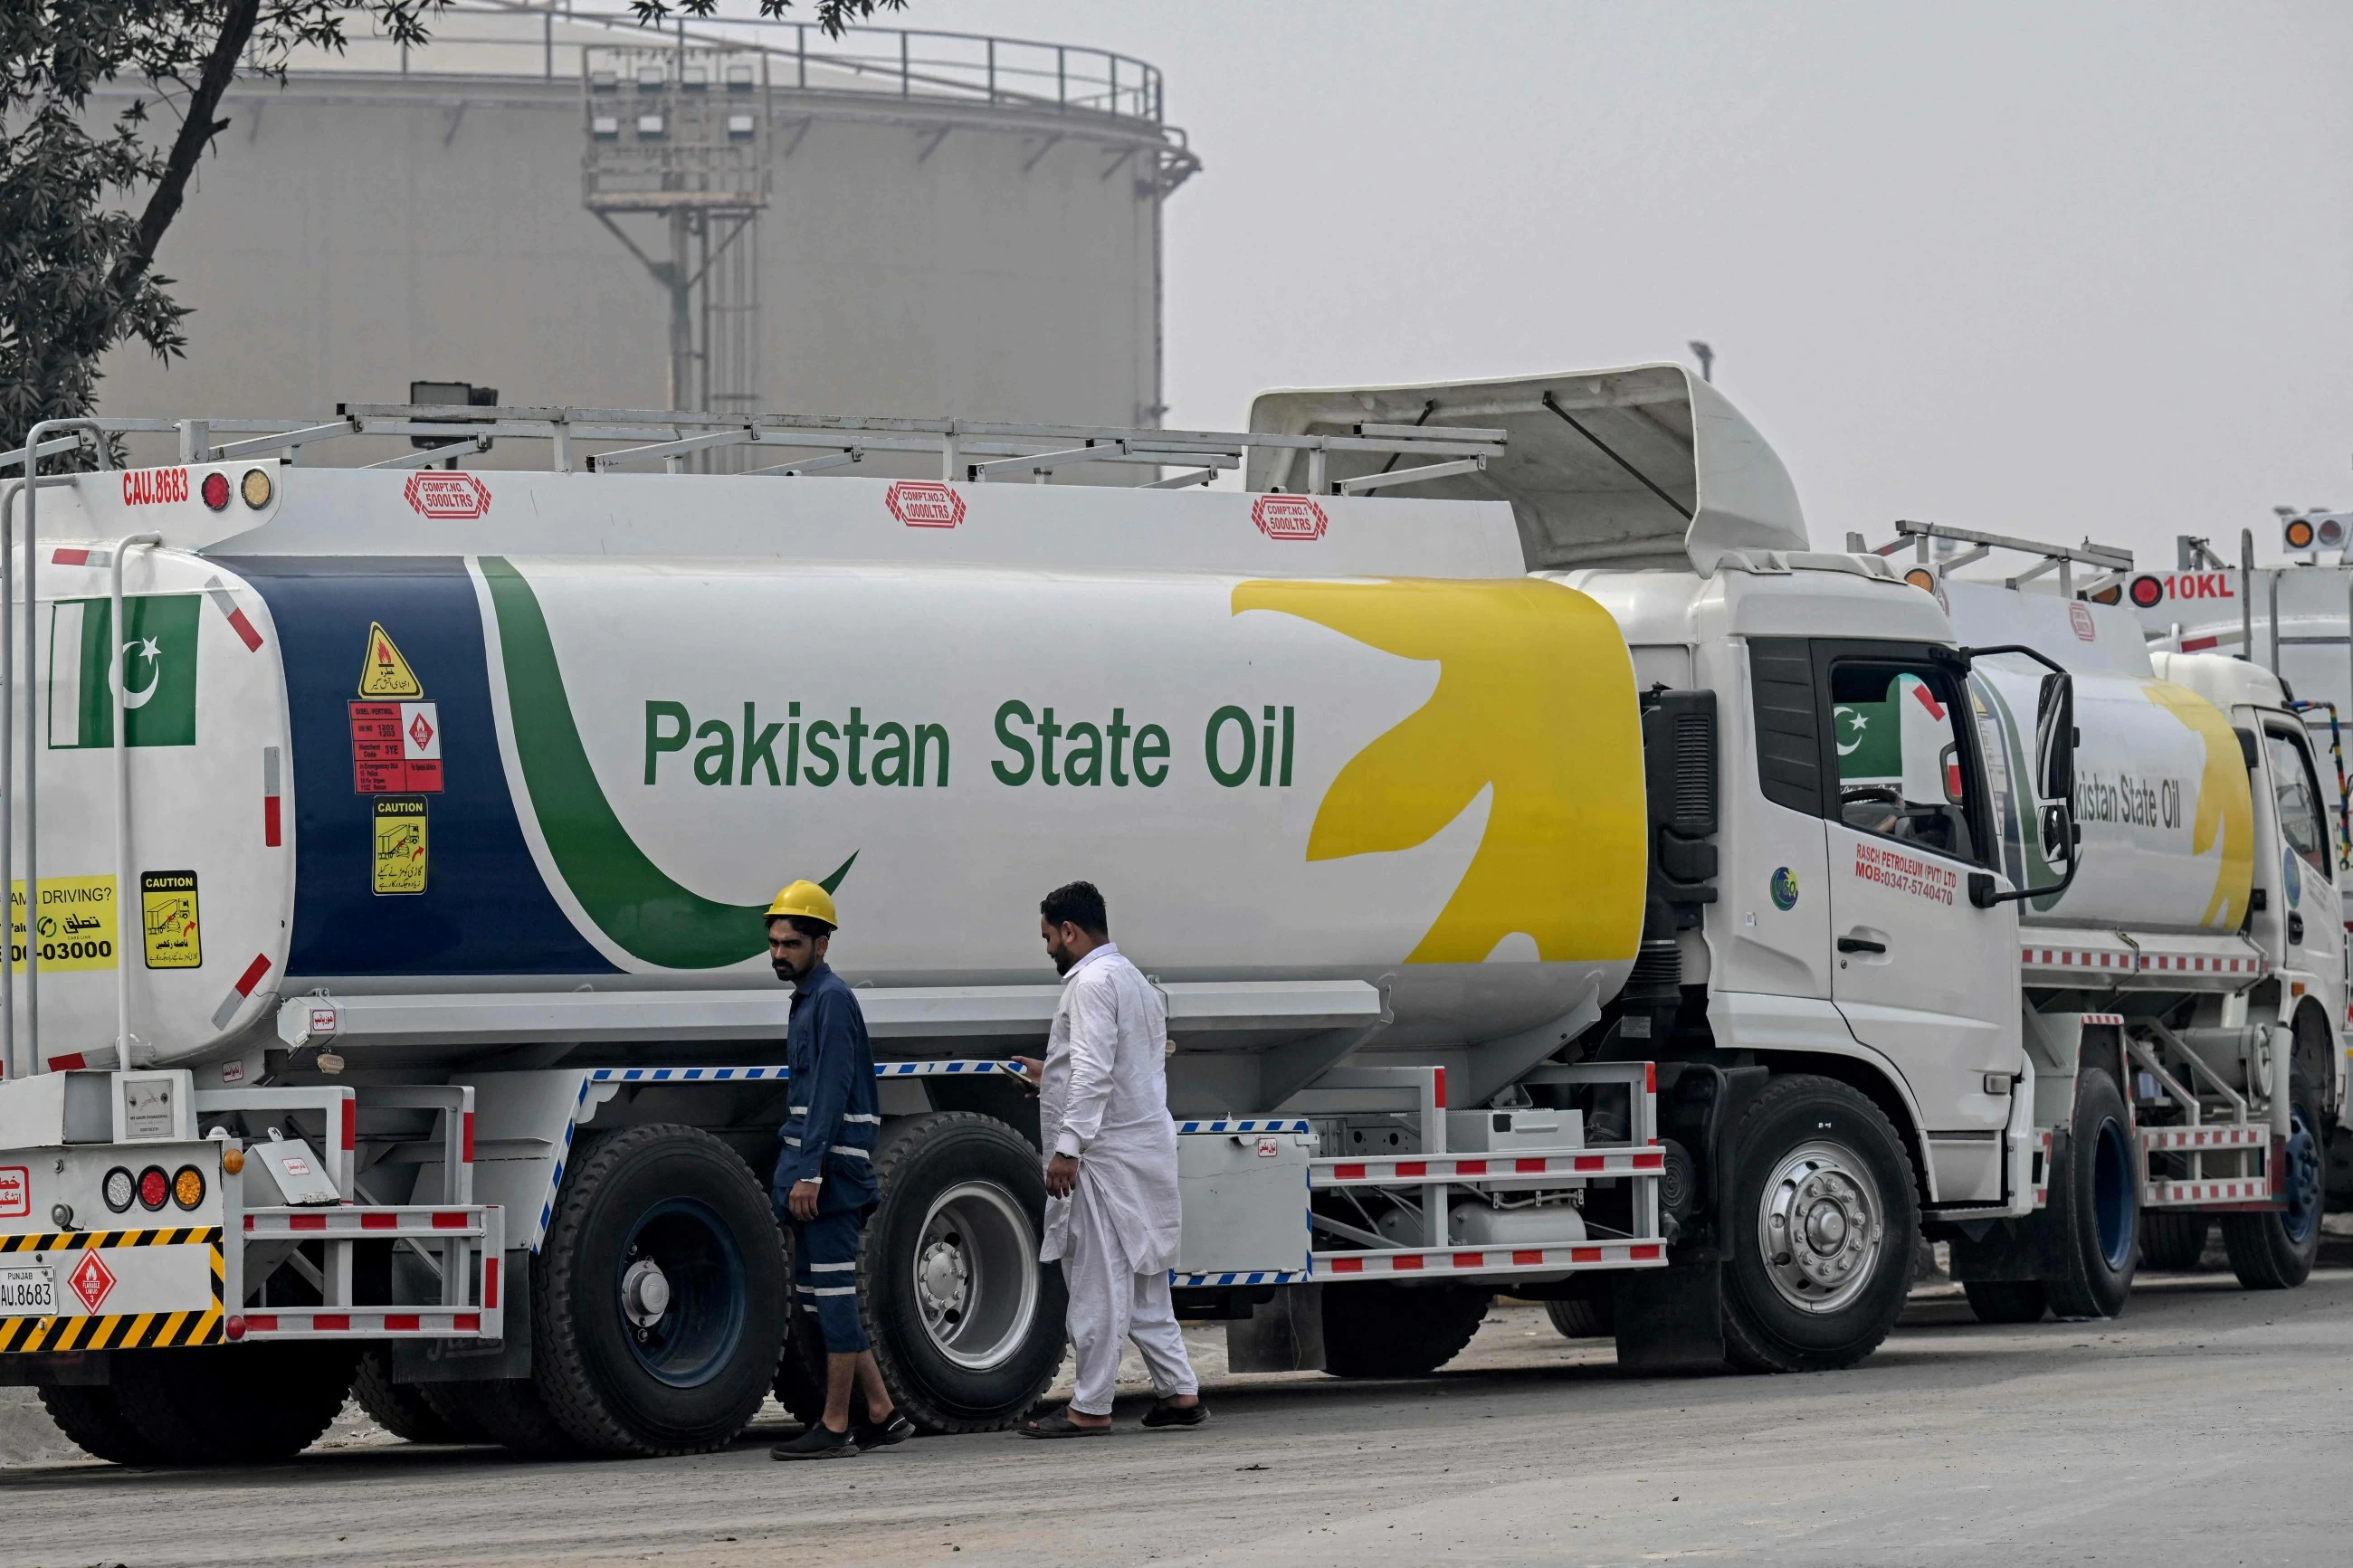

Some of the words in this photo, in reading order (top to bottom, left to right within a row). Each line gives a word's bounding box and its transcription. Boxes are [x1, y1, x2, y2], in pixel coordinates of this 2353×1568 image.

[123, 468, 188, 506] CAU.8683
[425, 493, 473, 508] 5000LTRS
[902, 490, 946, 502] COMPT.NO.2
[906, 503, 949, 519] 10000LTRS
[1267, 505, 1309, 516] COMPT.NO.1
[1269, 517, 1311, 531] 5000LTRS
[2164, 574, 2234, 599] 10KL
[385, 745, 398, 755] 3YE
[643, 699, 950, 787] Pakistan
[990, 698, 1171, 788] State
[1205, 705, 1295, 788] Oil
[2073, 770, 2118, 823] kistan
[2120, 774, 2158, 828] State
[2161, 778, 2181, 830] Oil
[377, 803, 424, 813] CAUTION
[1856, 842, 1881, 865] RASCH
[1881, 851, 1923, 878] PETROLEUM
[1925, 864, 1942, 884] (PVT)
[1943, 870, 1957, 889] LTD
[145, 877, 193, 888] CAUTION
[43, 888, 111, 905] DRIVING?
[7, 1271, 33, 1280] PUNJAB
[0, 1283, 52, 1306] AU.8683
[90, 1295, 94, 1303] 3
